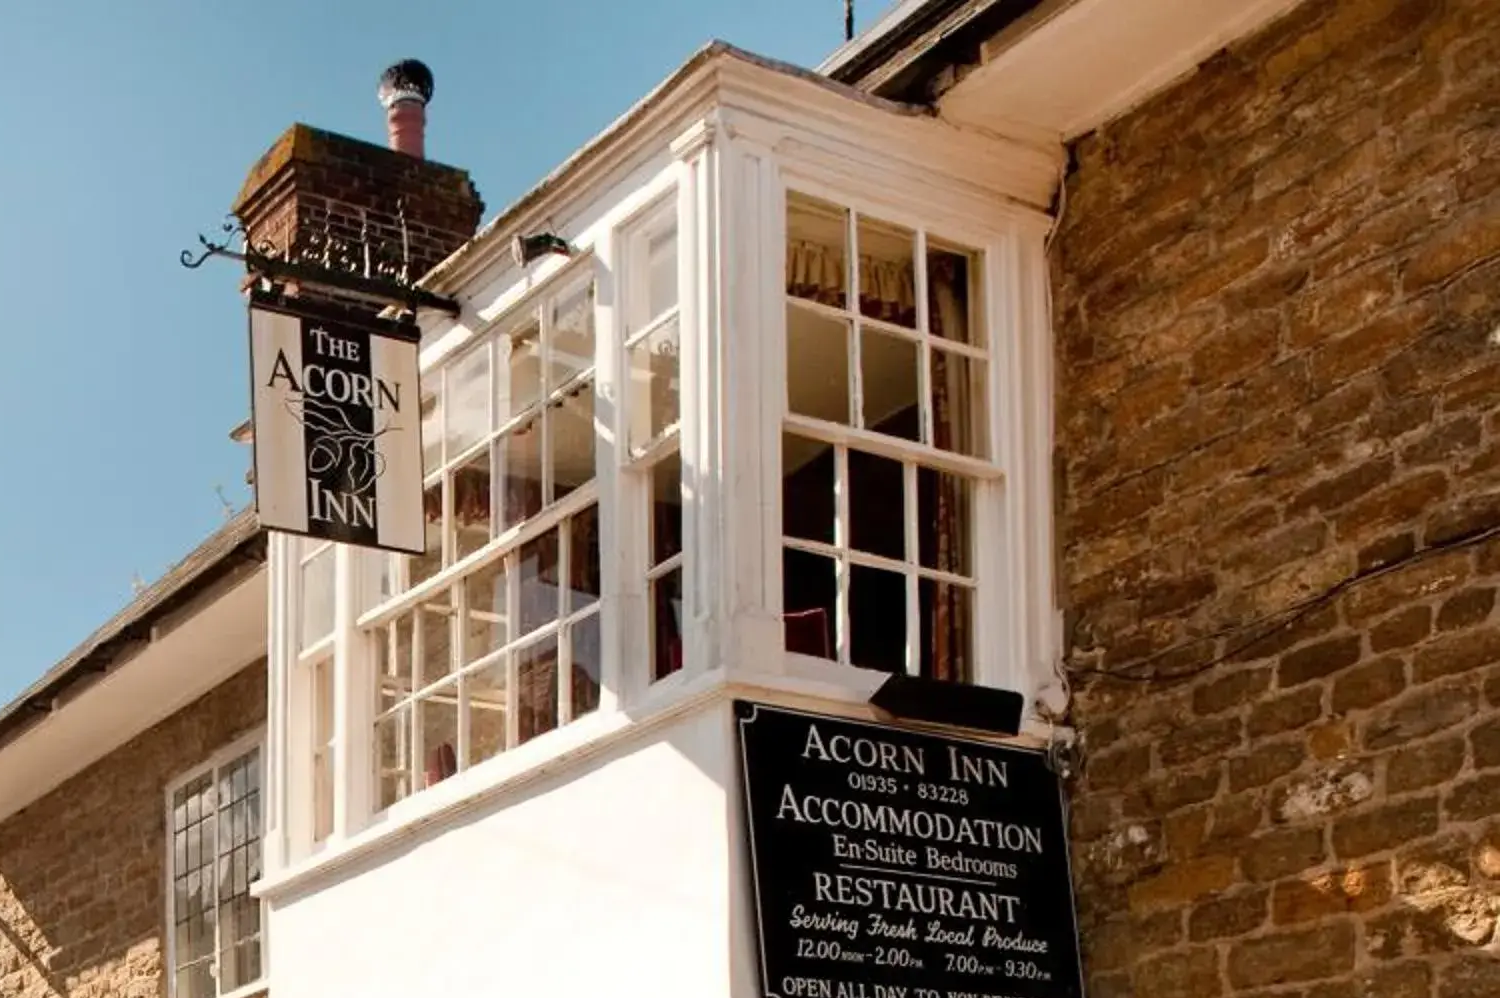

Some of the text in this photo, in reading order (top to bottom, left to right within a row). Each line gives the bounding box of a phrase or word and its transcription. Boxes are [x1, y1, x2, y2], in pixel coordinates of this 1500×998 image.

[310, 327, 360, 362] THE
[268, 348, 400, 412] ACORN
[309, 479, 376, 529] INN
[802, 724, 1007, 787] ACORN INN
[848, 772, 897, 794] 01935
[918, 784, 969, 805] 83228
[776, 784, 1042, 853] ACCOMMODATION
[926, 847, 1017, 878] Bedrooms
[814, 872, 1020, 923] RESTAURANT
[790, 905, 1047, 953] Serving Fresh Local Produce
[783, 976, 831, 998] OPEN
